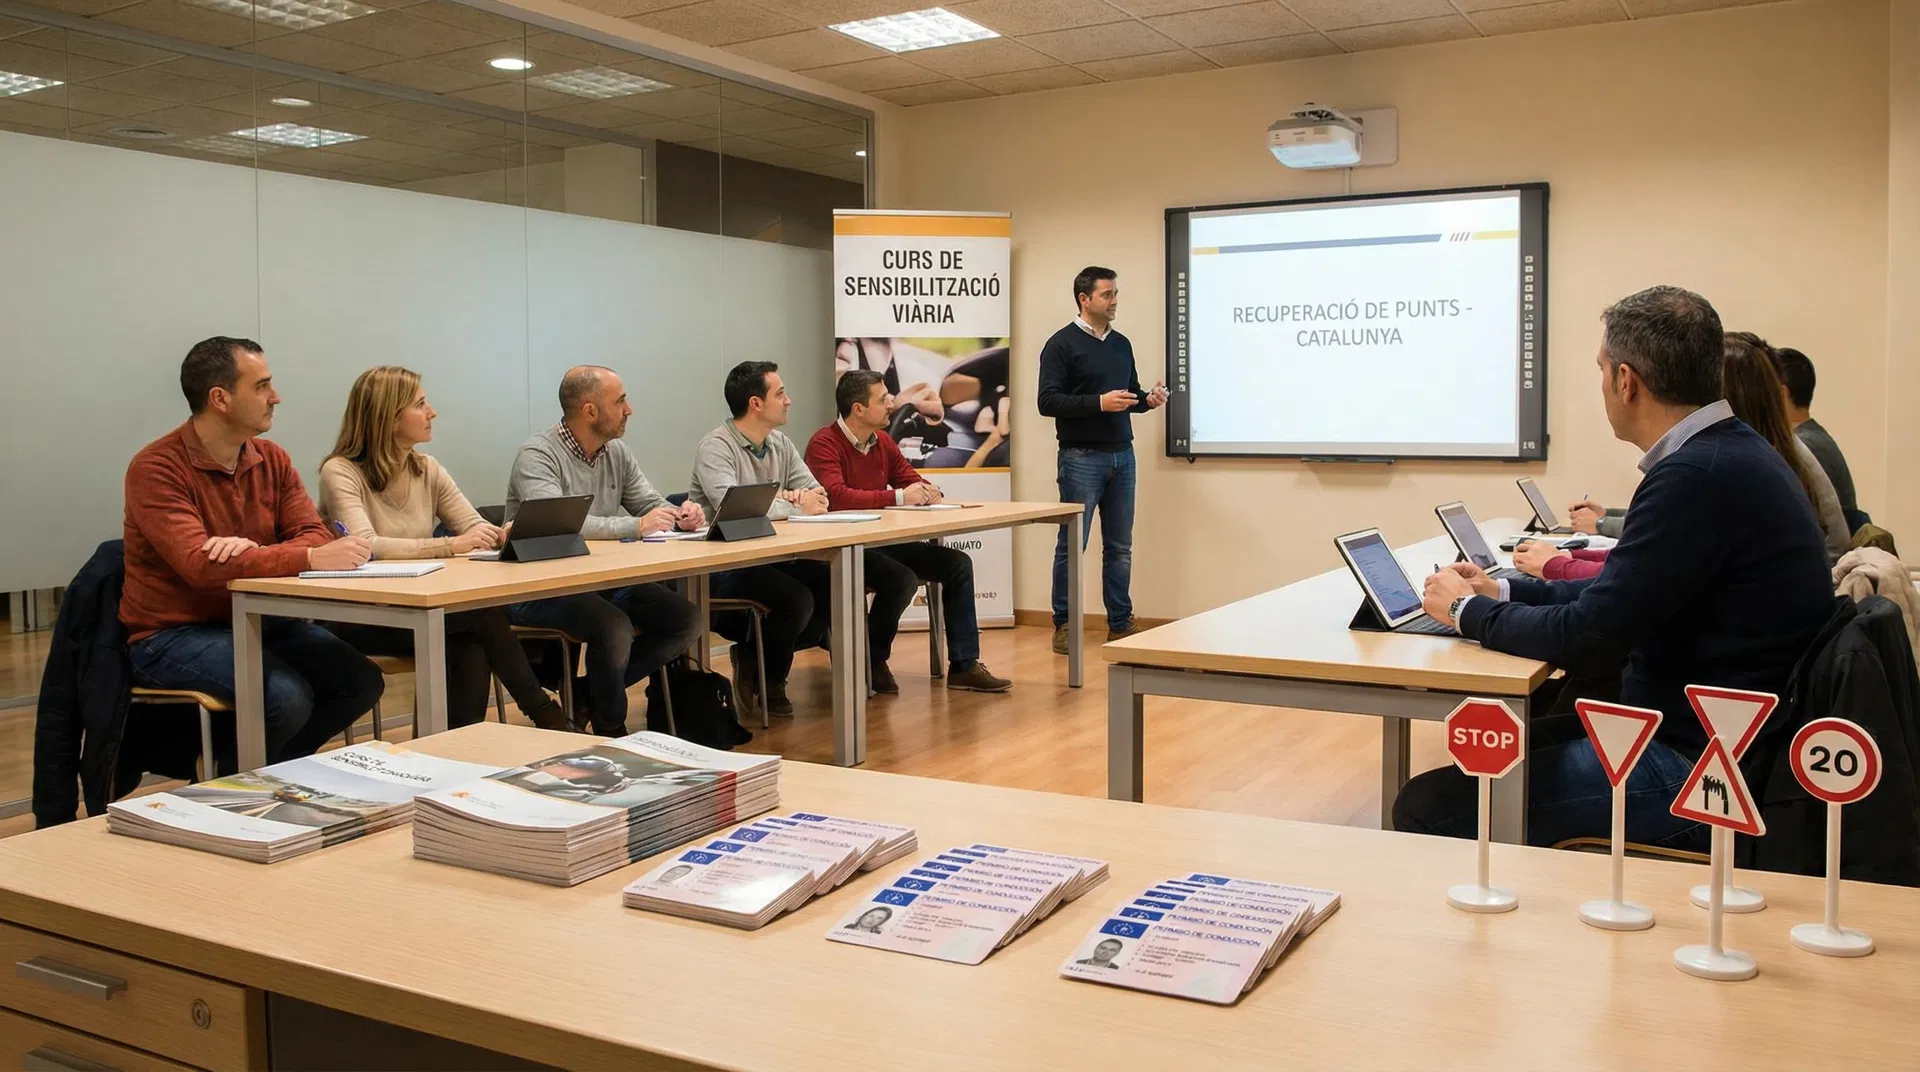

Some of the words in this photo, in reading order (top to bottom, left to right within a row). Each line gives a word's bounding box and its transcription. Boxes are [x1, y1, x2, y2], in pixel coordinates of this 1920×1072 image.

[882, 249, 933, 270] CURS
[940, 250, 963, 270] DE
[844, 272, 1000, 297] SENSIBILITZACIÓ
[892, 298, 955, 324] VIÀRIA
[1233, 298, 1359, 324] RECUPERACIÓ
[1365, 302, 1389, 319] DE
[1395, 300, 1460, 318] PUNTS
[1296, 327, 1403, 347] CATALUNYA
[1453, 727, 1514, 749] STOP
[1809, 745, 1859, 777] 20
